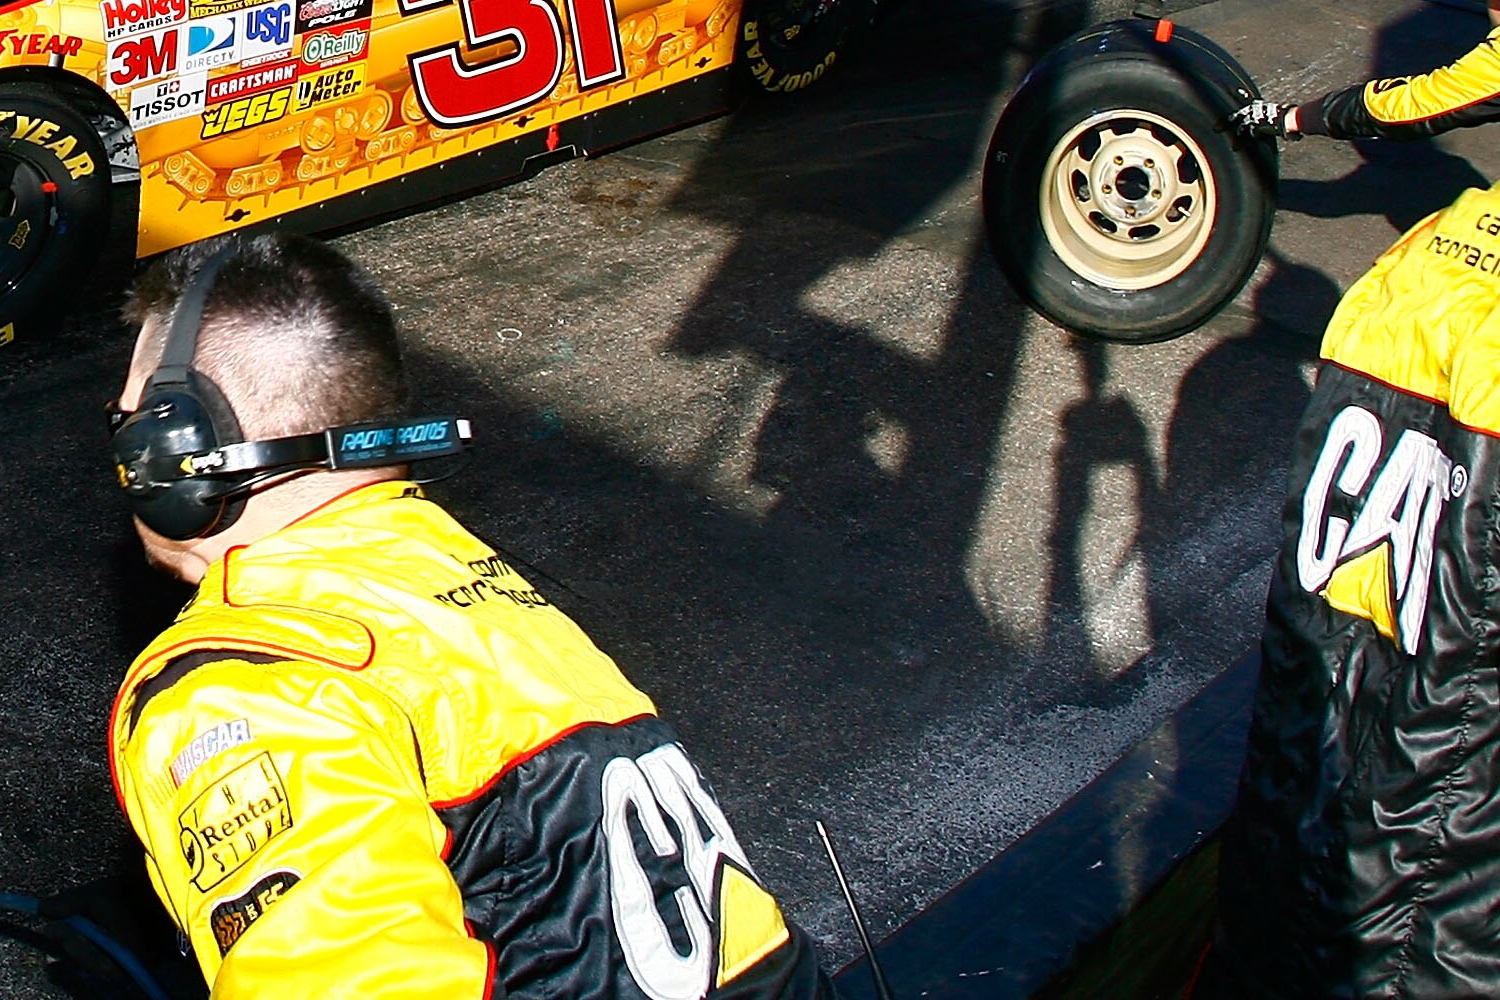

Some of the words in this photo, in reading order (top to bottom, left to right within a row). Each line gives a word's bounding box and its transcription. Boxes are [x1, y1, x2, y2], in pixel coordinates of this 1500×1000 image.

[191, 2, 243, 18] MECHANIX
[246, 3, 291, 45] USG
[308, 9, 358, 28] POLE
[108, 27, 125, 38] HP
[305, 32, 365, 61] O'Reilly
[110, 29, 178, 86] 3M
[186, 51, 236, 70] DIRECTV
[211, 65, 295, 98] CRAFTSMAN
[311, 81, 362, 103] Meter
[315, 69, 354, 88] Auto
[132, 89, 205, 121] TISSOT
[203, 88, 292, 139] JEGS
[340, 428, 395, 451] RACING
[396, 421, 449, 444] RADIOS
[1297, 404, 1451, 656] CAT
[200, 786, 284, 849] Rental
